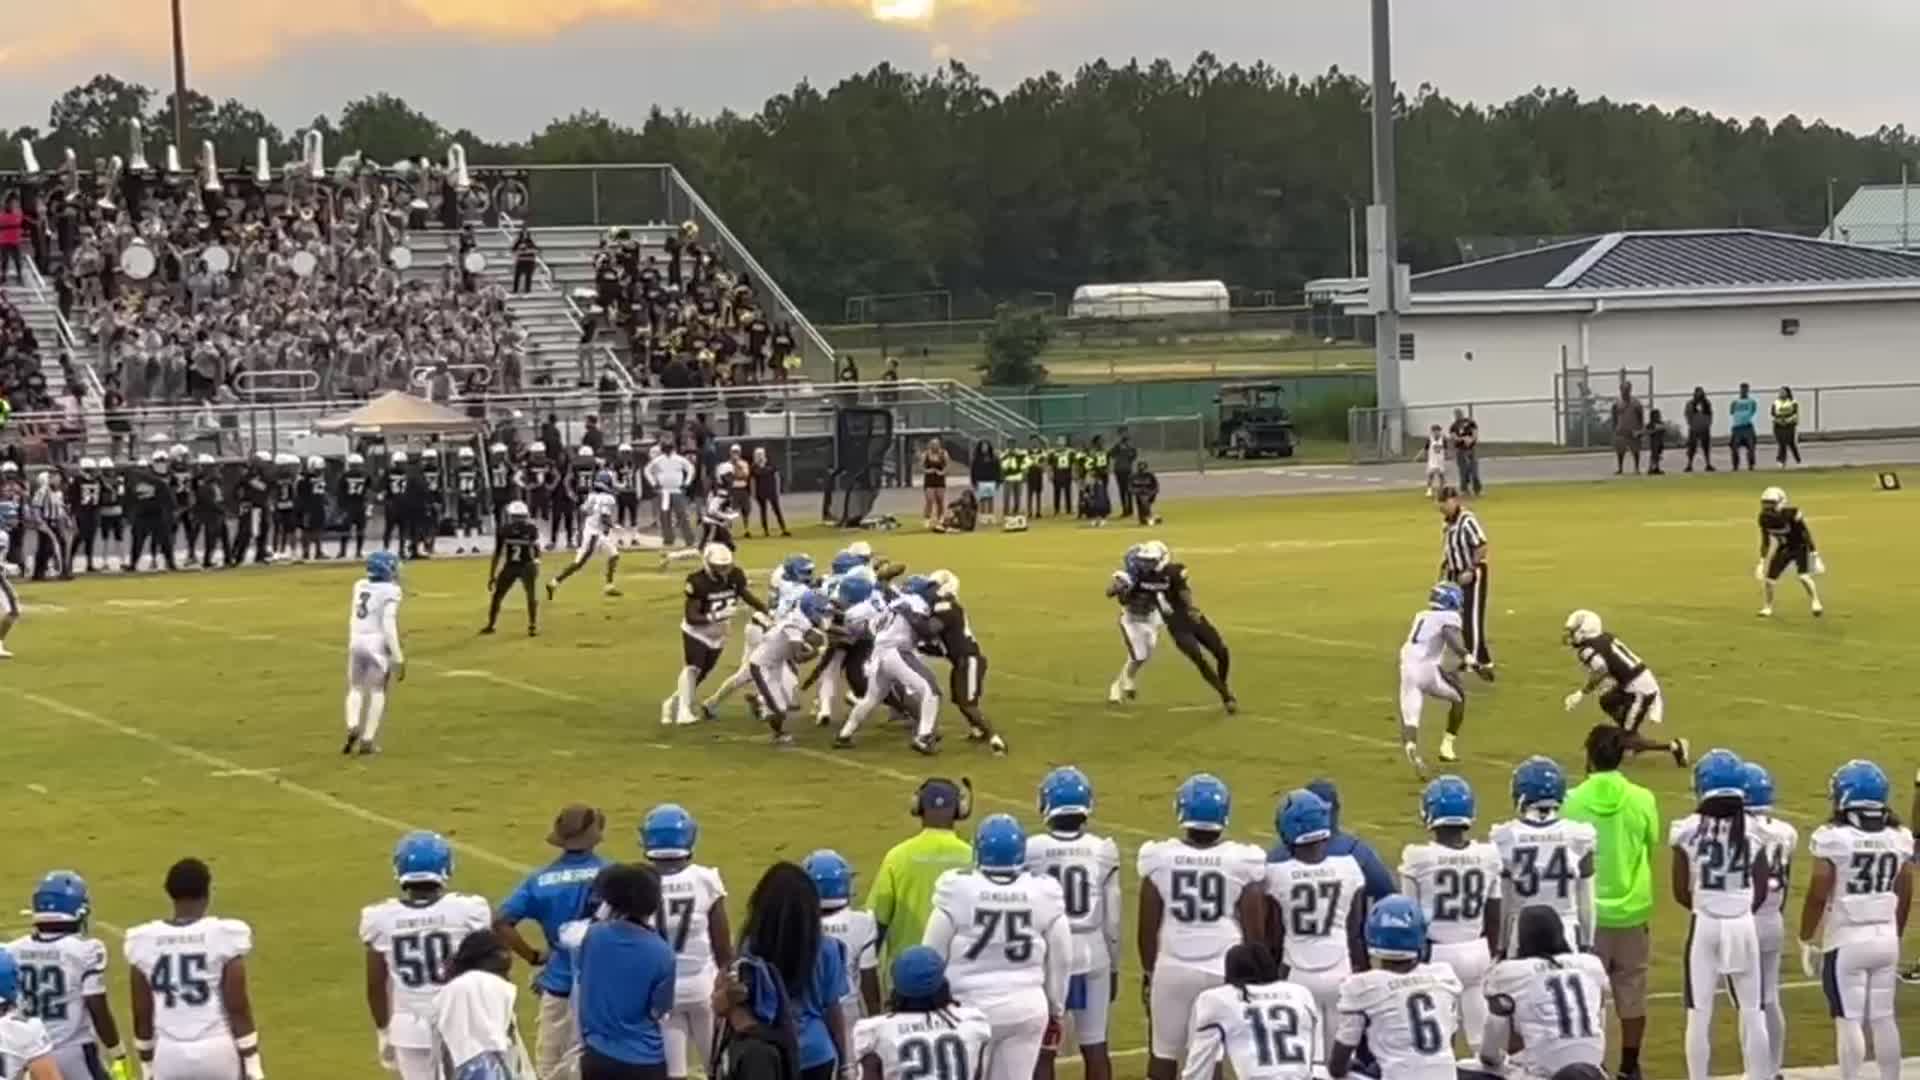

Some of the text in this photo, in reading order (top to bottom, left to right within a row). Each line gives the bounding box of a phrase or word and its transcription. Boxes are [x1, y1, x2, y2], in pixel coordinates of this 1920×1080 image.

[1412, 619, 1426, 644] 1
[1511, 845, 1576, 899] 34
[1698, 841, 1751, 890] 24
[1846, 852, 1898, 895] 30
[1171, 870, 1226, 923] 59
[1290, 880, 1342, 937] 27
[1433, 868, 1486, 922] 28
[391, 931, 451, 988] 50
[964, 908, 1033, 963] 75
[152, 954, 210, 1009] 45
[1545, 974, 1594, 1039] 11
[1243, 1005, 1306, 1066] 12
[1407, 992, 1442, 1055] 6
[897, 1034, 968, 1080] 20
